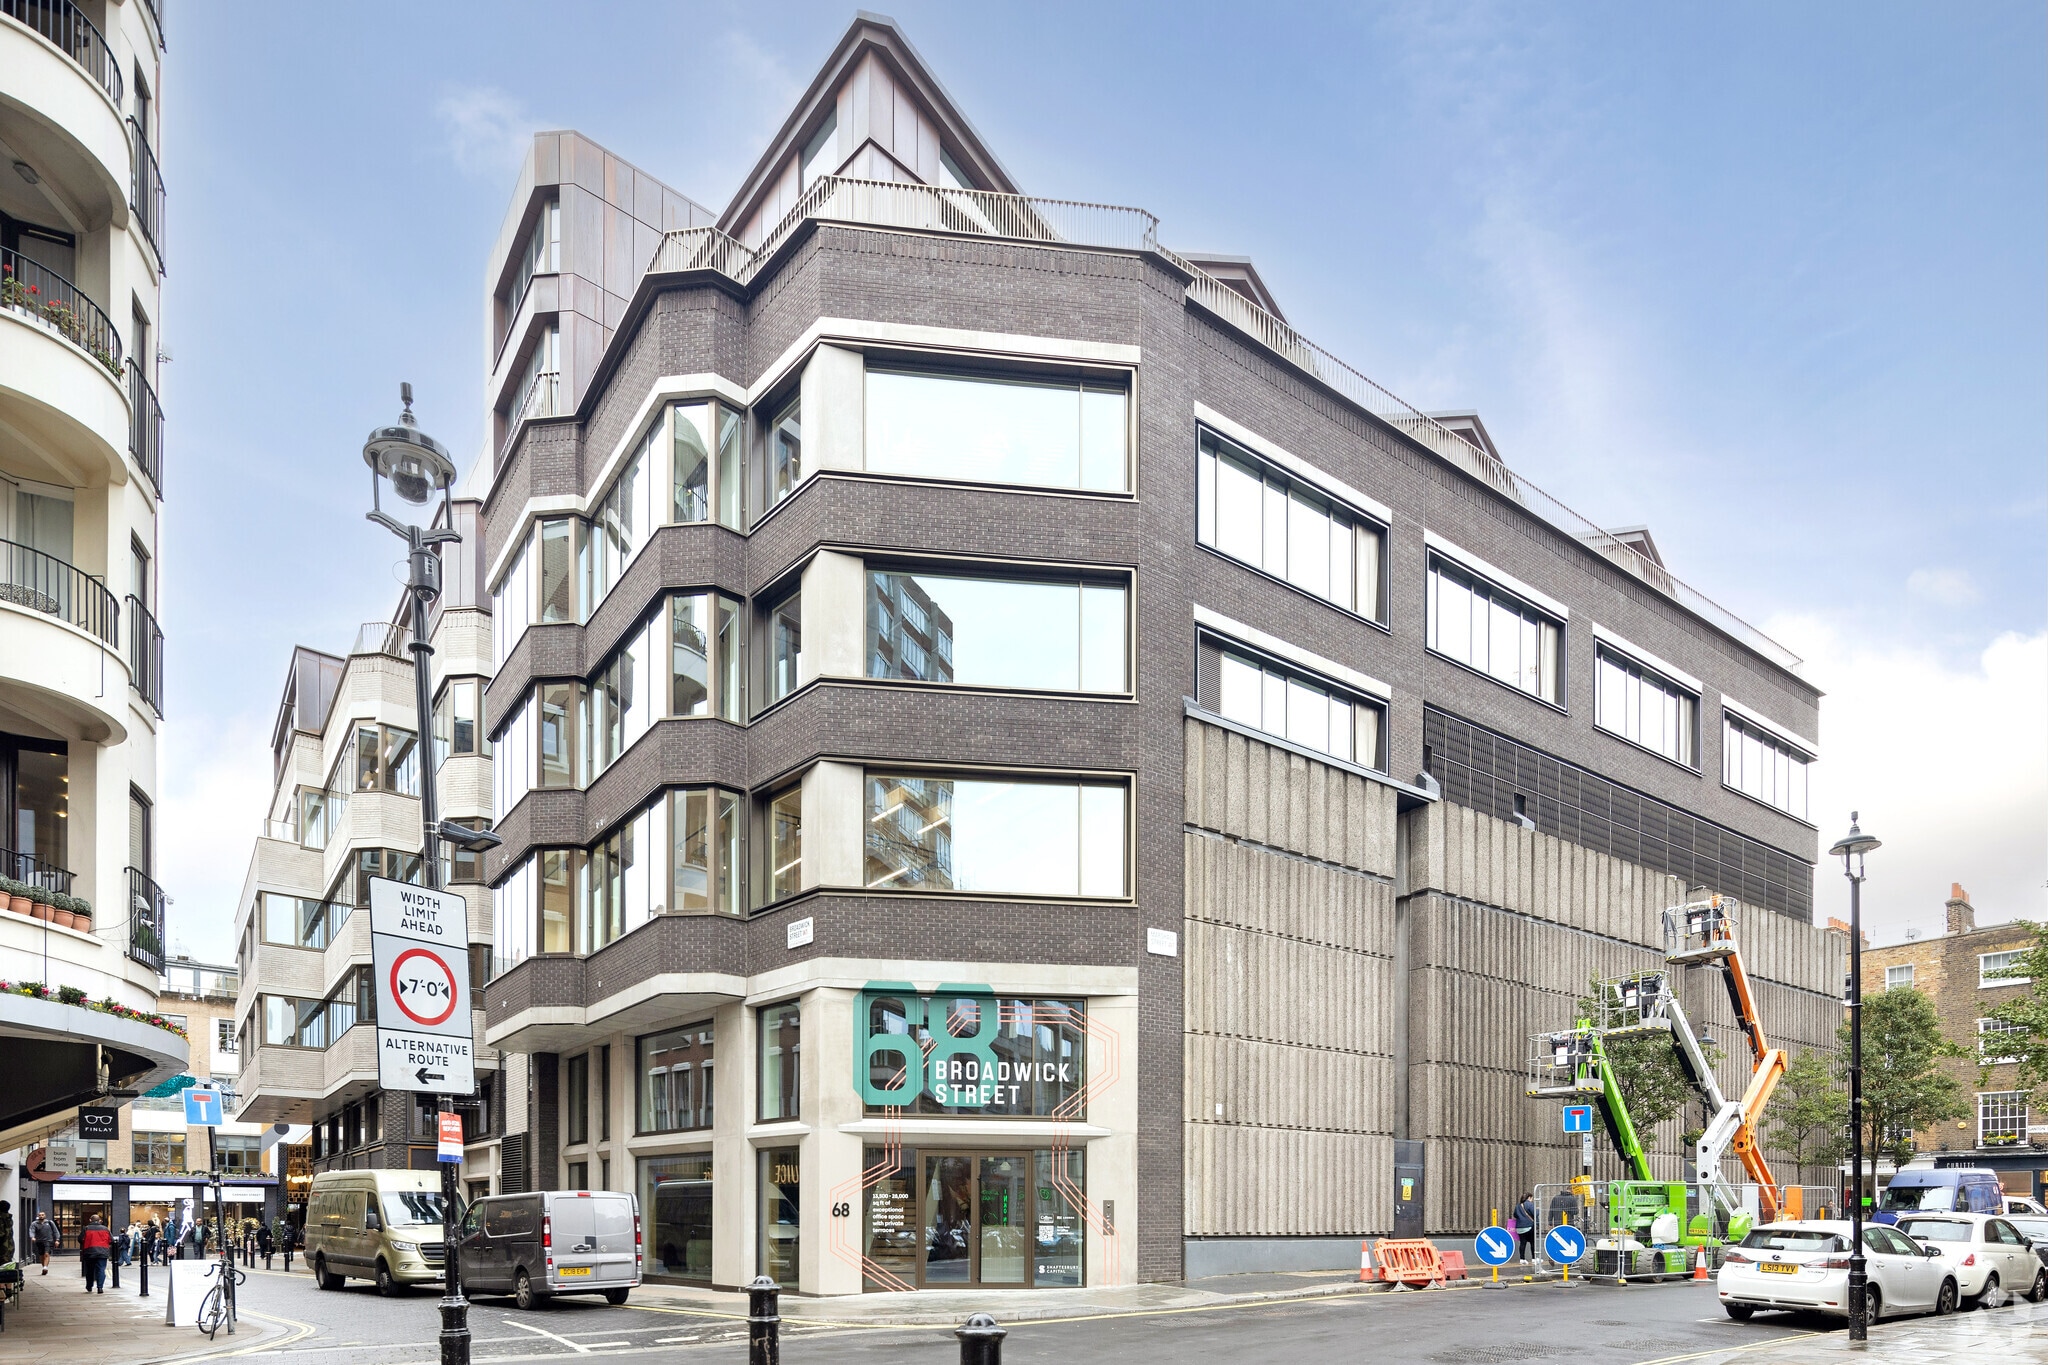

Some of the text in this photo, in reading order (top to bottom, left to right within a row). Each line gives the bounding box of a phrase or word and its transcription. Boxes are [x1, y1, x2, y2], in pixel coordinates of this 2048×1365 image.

[400, 890, 441, 910] WIDTH
[404, 905, 437, 921] LIMIT
[400, 918, 443, 935] AHEAD
[789, 921, 810, 932] BROADWICK
[789, 930, 802, 940] STREET
[385, 1038, 468, 1056] ALTERNATIVE
[853, 981, 998, 1107] 68
[408, 1053, 449, 1067] ROUTE
[935, 1060, 1069, 1082] BROADWICK
[935, 1084, 1020, 1105] STREET
[313, 1194, 358, 1215] DRINKS
[832, 1202, 850, 1217] 68
